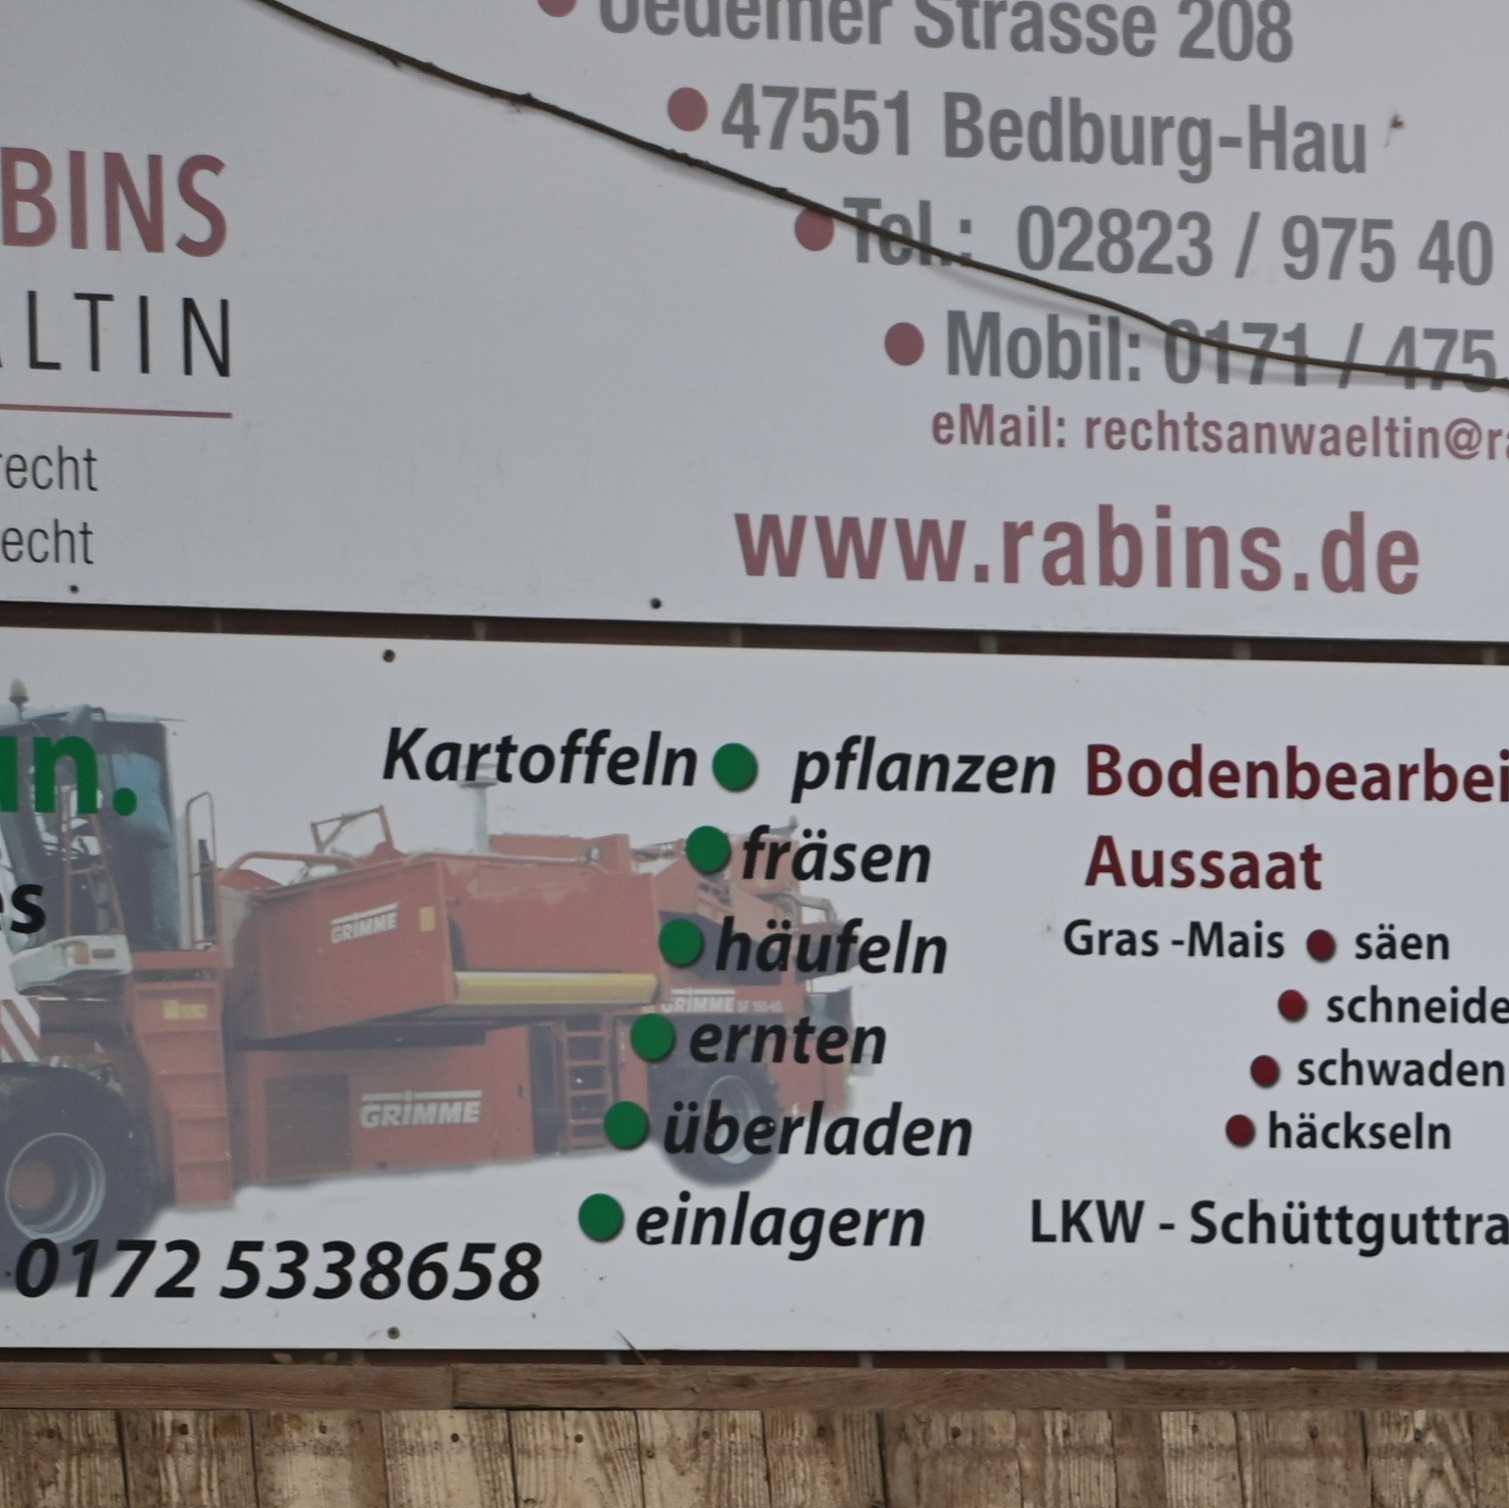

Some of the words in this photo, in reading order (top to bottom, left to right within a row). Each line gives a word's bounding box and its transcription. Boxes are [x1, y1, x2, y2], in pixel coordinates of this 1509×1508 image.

[914, 0, 1157, 59] Strasse
[1179, 0, 1294, 63] 208
[721, 82, 911, 156] 47551
[943, 91, 1368, 183] Bedburg-Hau
[1017, 204, 1214, 278] 02823
[1235, 211, 1260, 280] /
[1281, 214, 1397, 283] 975
[1417, 218, 1494, 286] 40
[0, 290, 230, 378] LTIN
[946, 309, 1141, 384] Mobil:
[1164, 318, 1311, 387] 0171
[1385, 325, 1497, 394] 475
[932, 403, 1066, 449] eMail:
[0, 444, 98, 492] echt
[734, 503, 1420, 595] www.rabins.de
[383, 726, 698, 789] Kartoffeln
[791, 735, 1056, 803] pflanzen
[737, 825, 931, 884] fräsen
[1084, 834, 1324, 891] Aussaat
[330, 911, 399, 944] GRIMME
[715, 917, 947, 976] häufeln
[1063, 919, 1160, 958] Gras
[1354, 926, 1450, 962] säen
[689, 1015, 886, 1066] ernten
[1296, 1047, 1506, 1088] schwaden
[359, 1099, 482, 1129] GRIMME
[663, 1100, 973, 1158] überladen
[1267, 1110, 1453, 1152] häckseln
[635, 1190, 925, 1261] einlagern
[1030, 1199, 1145, 1245] LKW
[14, 1237, 198, 1300] 0172
[219, 1240, 543, 1303] 5338658
